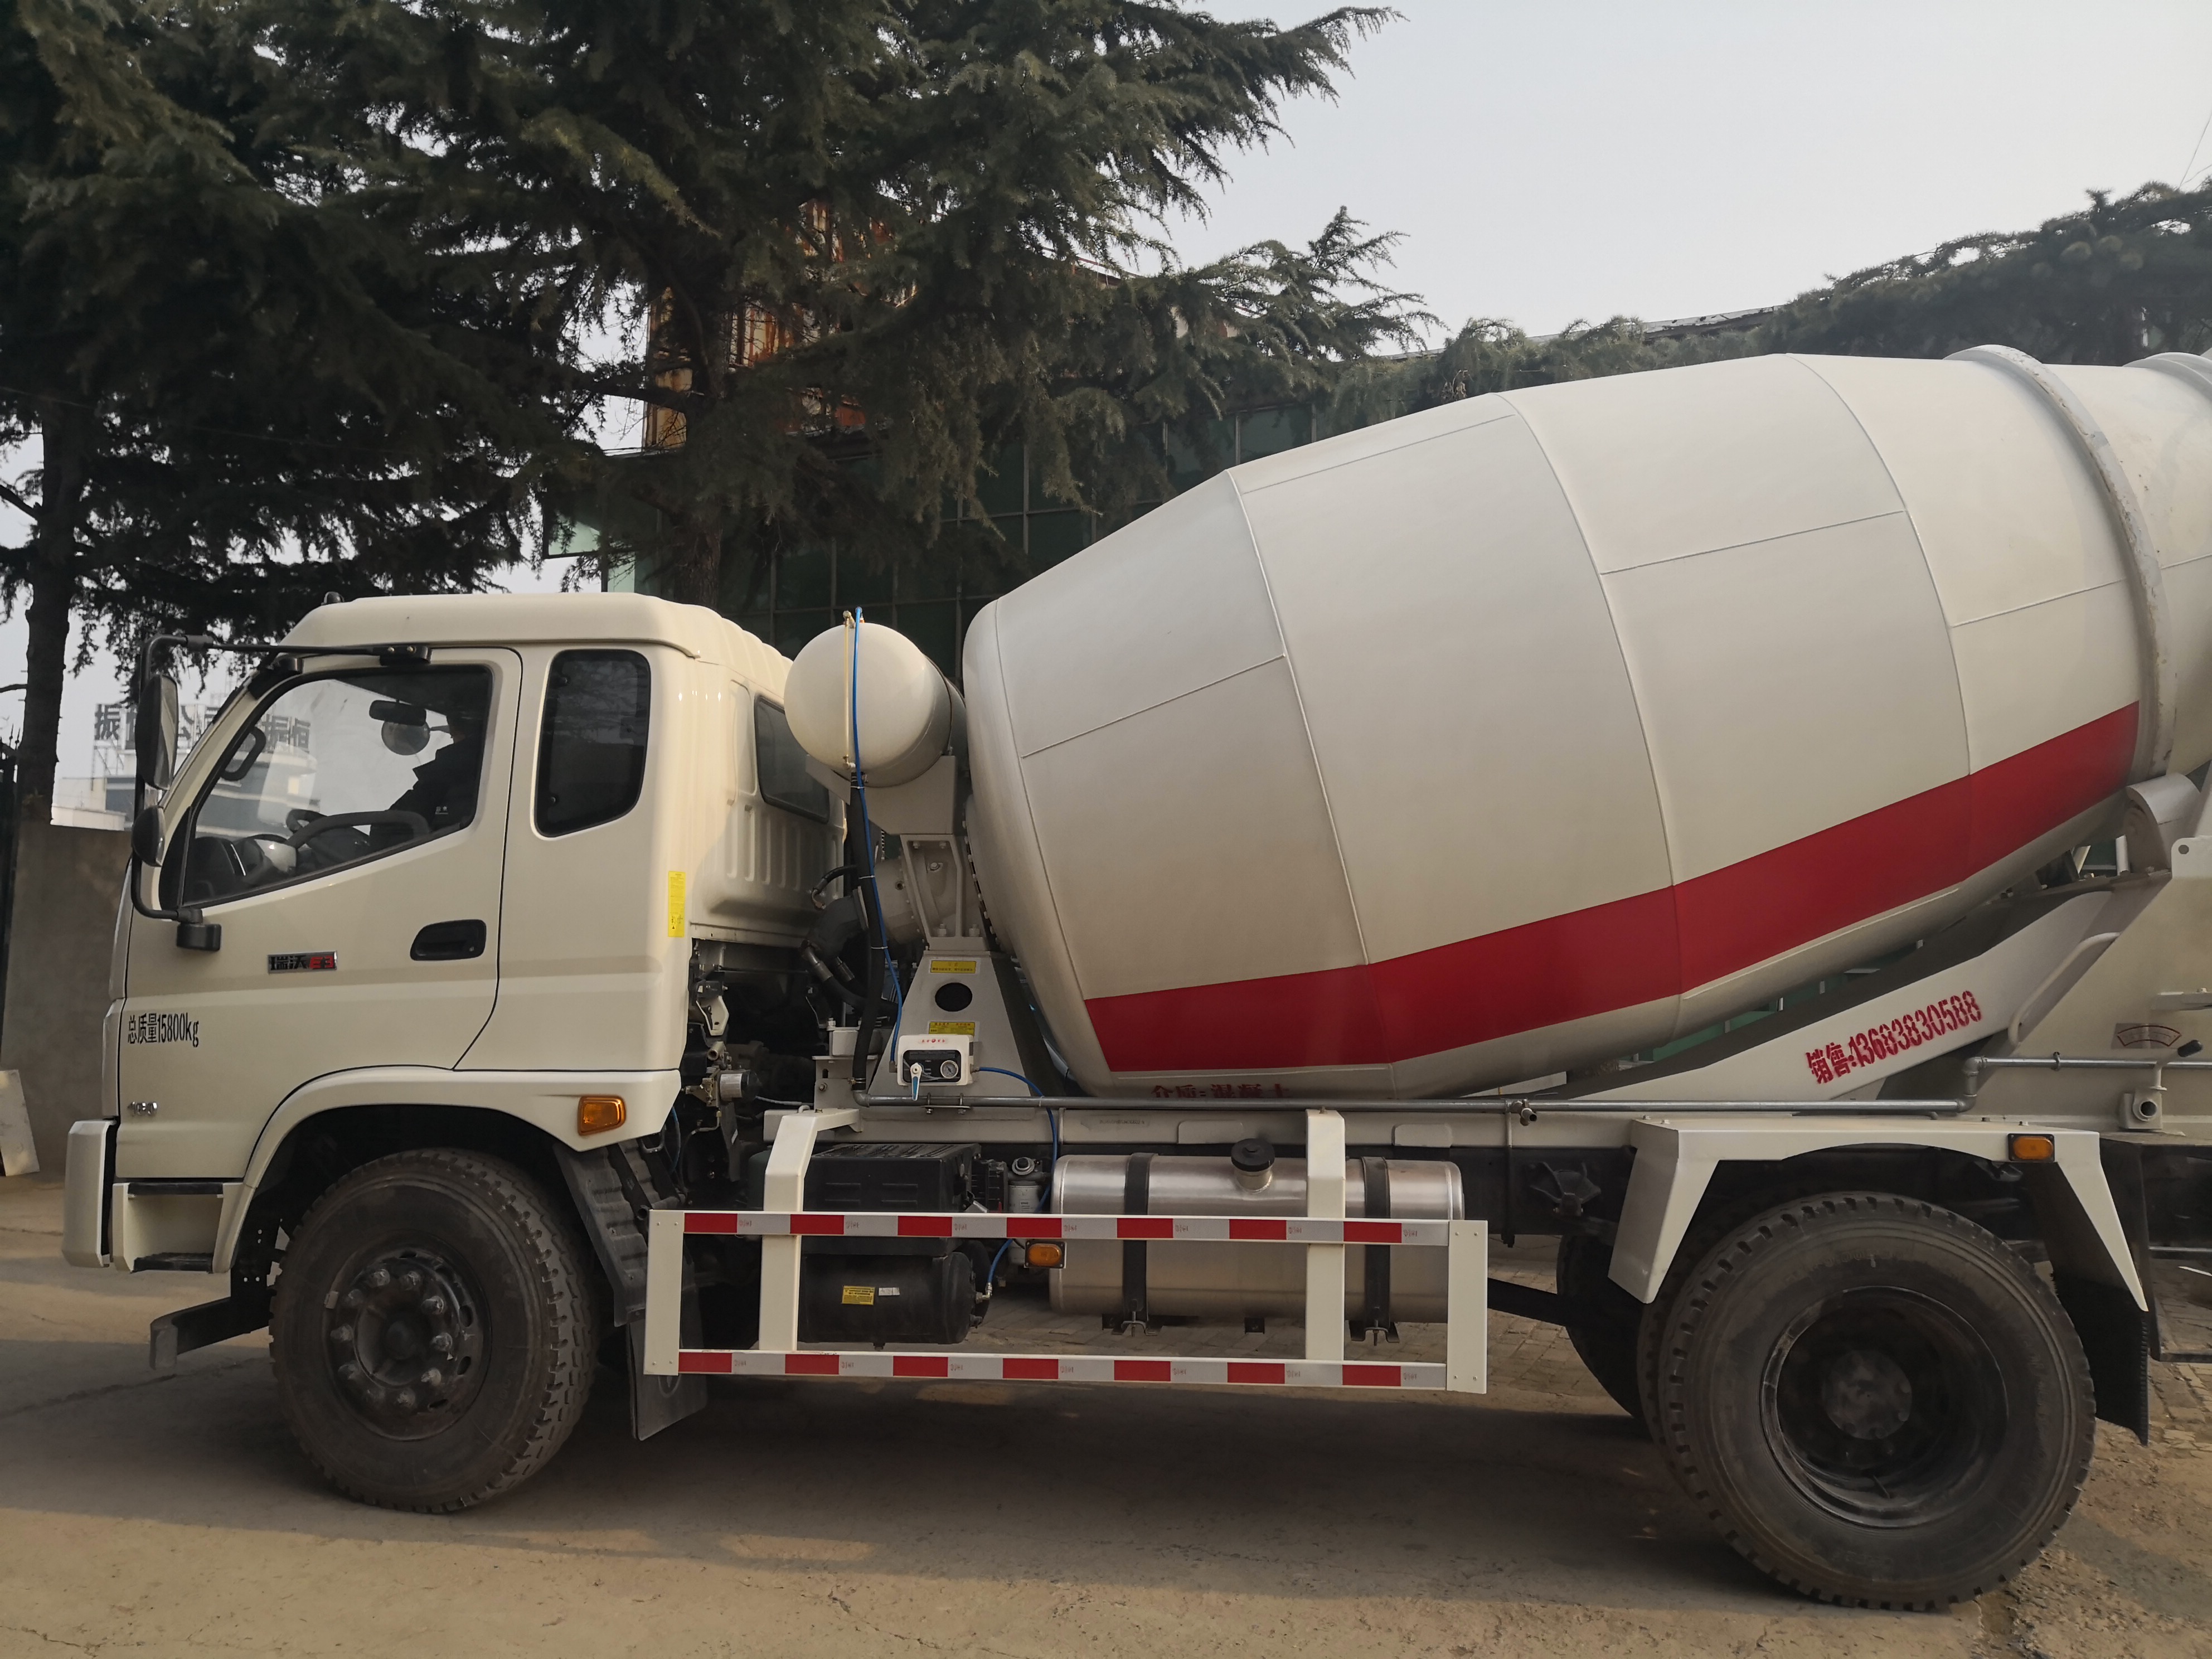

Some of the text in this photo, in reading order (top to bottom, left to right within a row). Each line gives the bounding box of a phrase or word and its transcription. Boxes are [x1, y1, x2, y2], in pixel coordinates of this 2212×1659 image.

[270, 954, 307, 971] 瑞沃
[128, 1012, 199, 1048] 总质量15800kg
[1805, 990, 1982, 1084] 销售:13683830588
